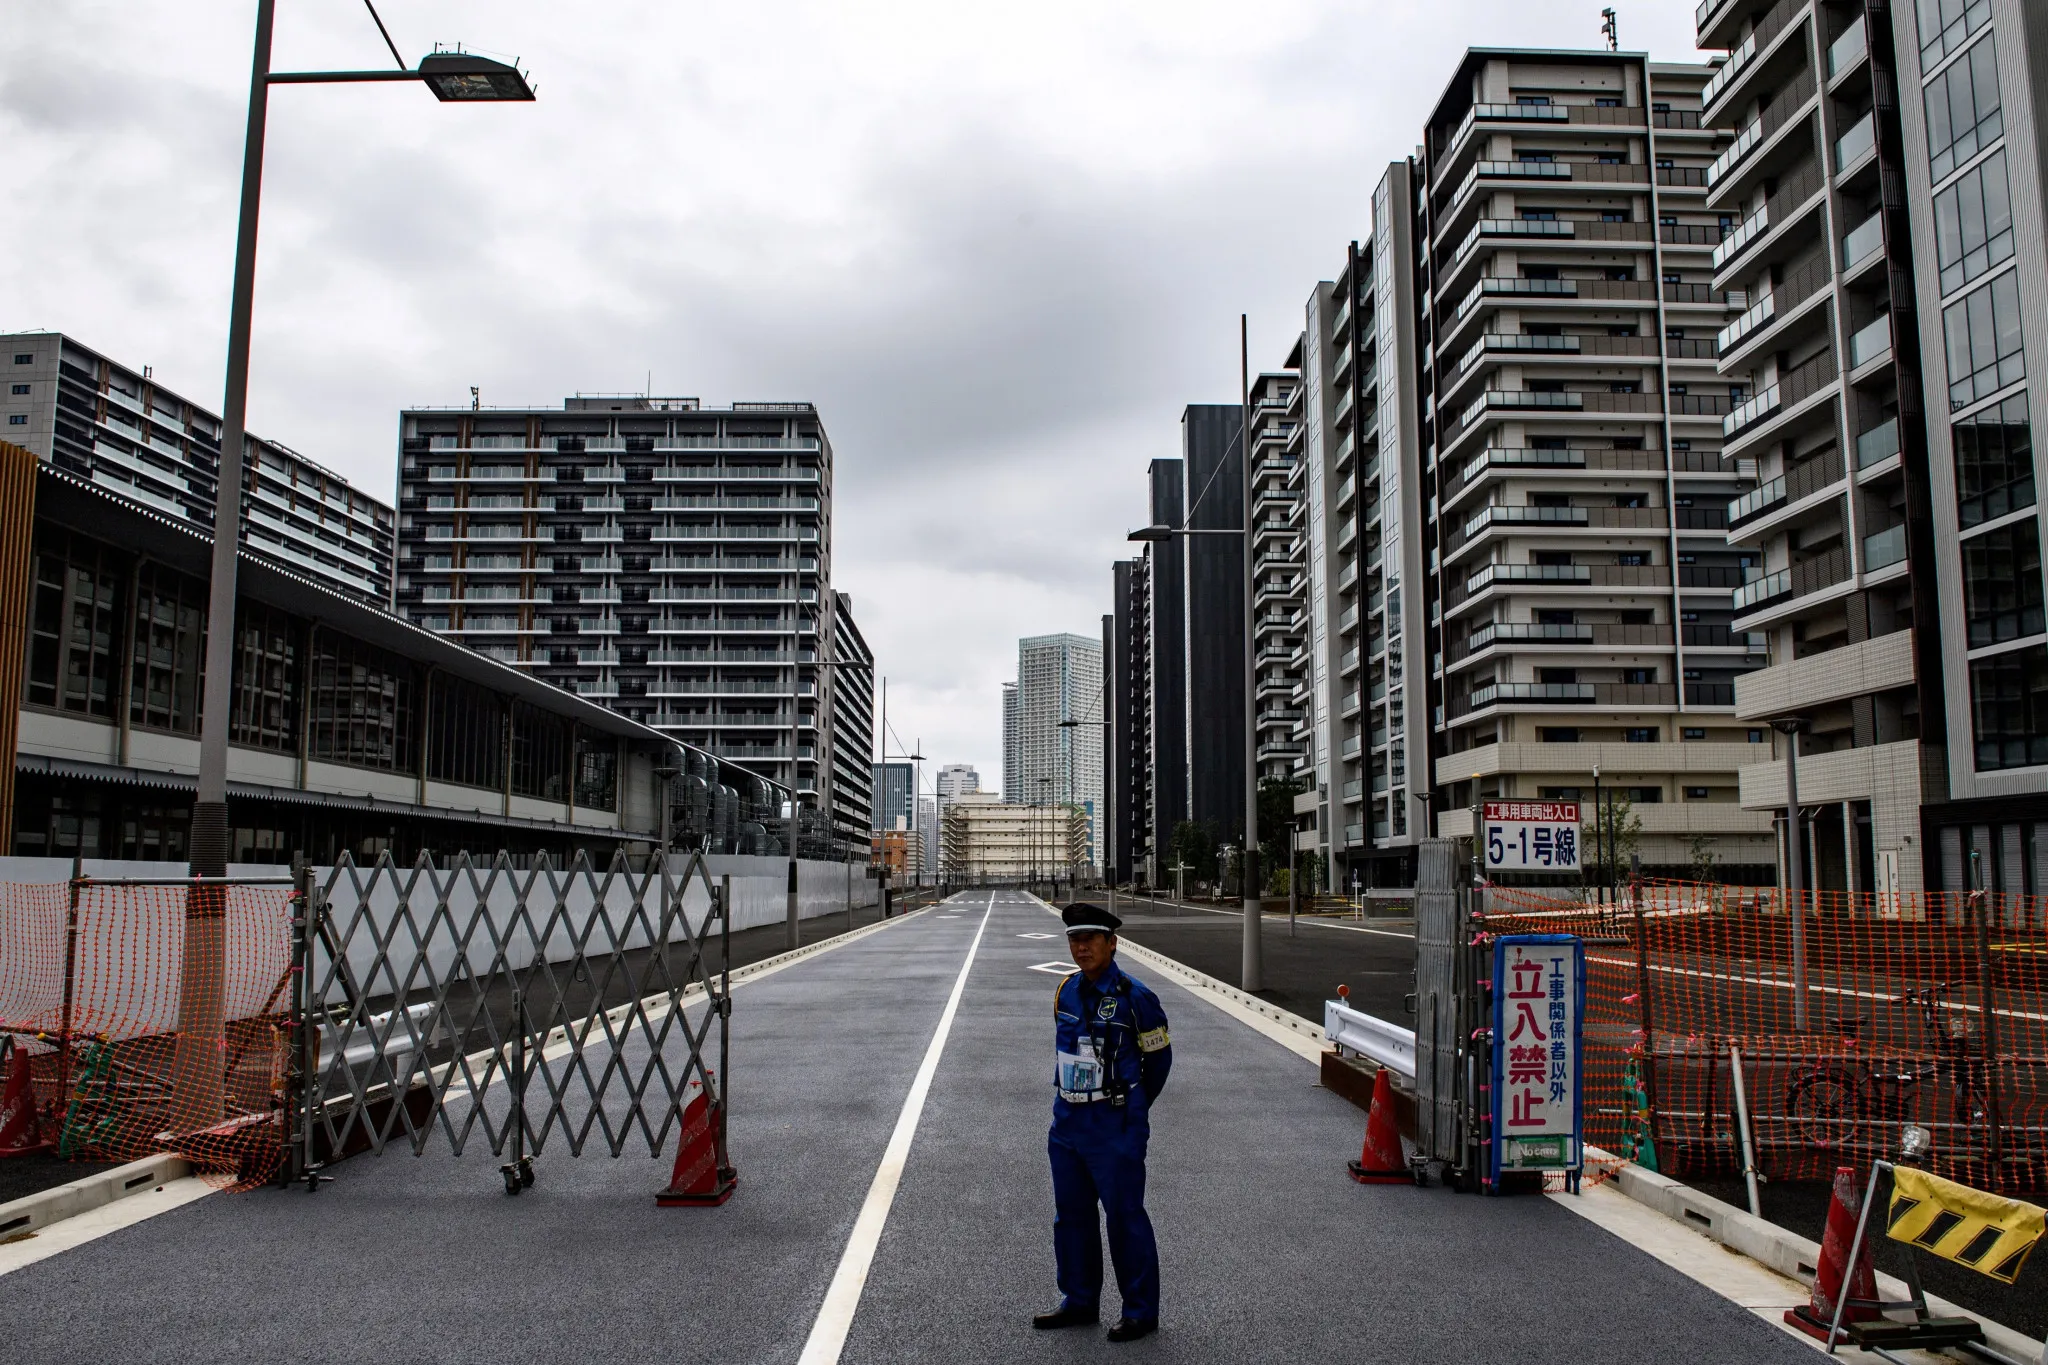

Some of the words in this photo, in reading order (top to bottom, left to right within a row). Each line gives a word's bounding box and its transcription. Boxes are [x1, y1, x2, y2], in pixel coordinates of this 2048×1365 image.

[1487, 803, 1576, 820] 工事用車両出入口
[1488, 826, 1576, 866] 5-1号線
[1508, 959, 1547, 1127] 立入禁止
[1549, 958, 1566, 1102] 工事関係者以外
[1520, 1143, 1533, 1157] No
